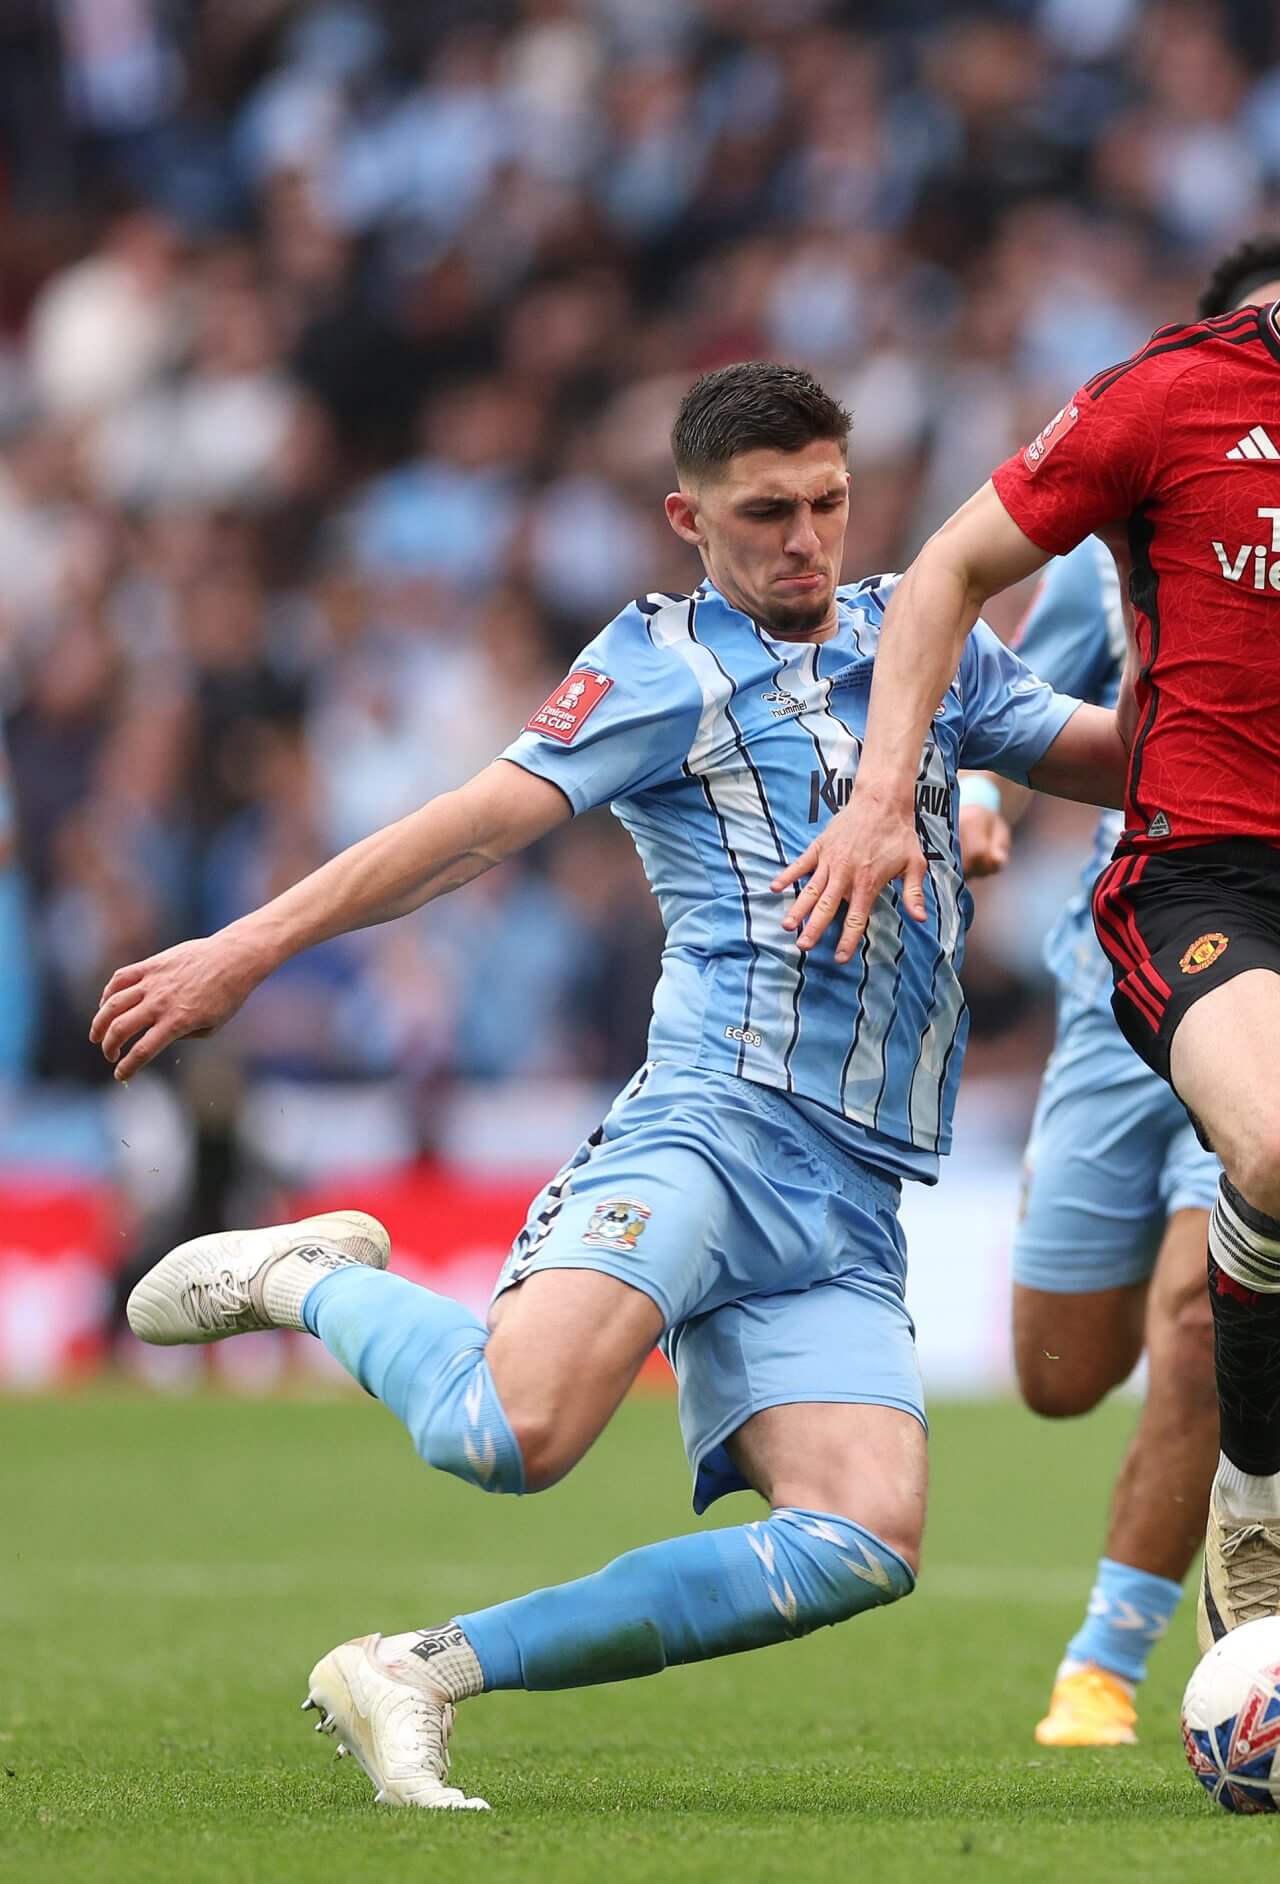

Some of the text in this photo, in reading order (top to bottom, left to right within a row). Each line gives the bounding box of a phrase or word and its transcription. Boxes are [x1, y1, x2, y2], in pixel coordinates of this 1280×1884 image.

[771, 699, 808, 718] hummel
[535, 713, 573, 731] FA CUP
